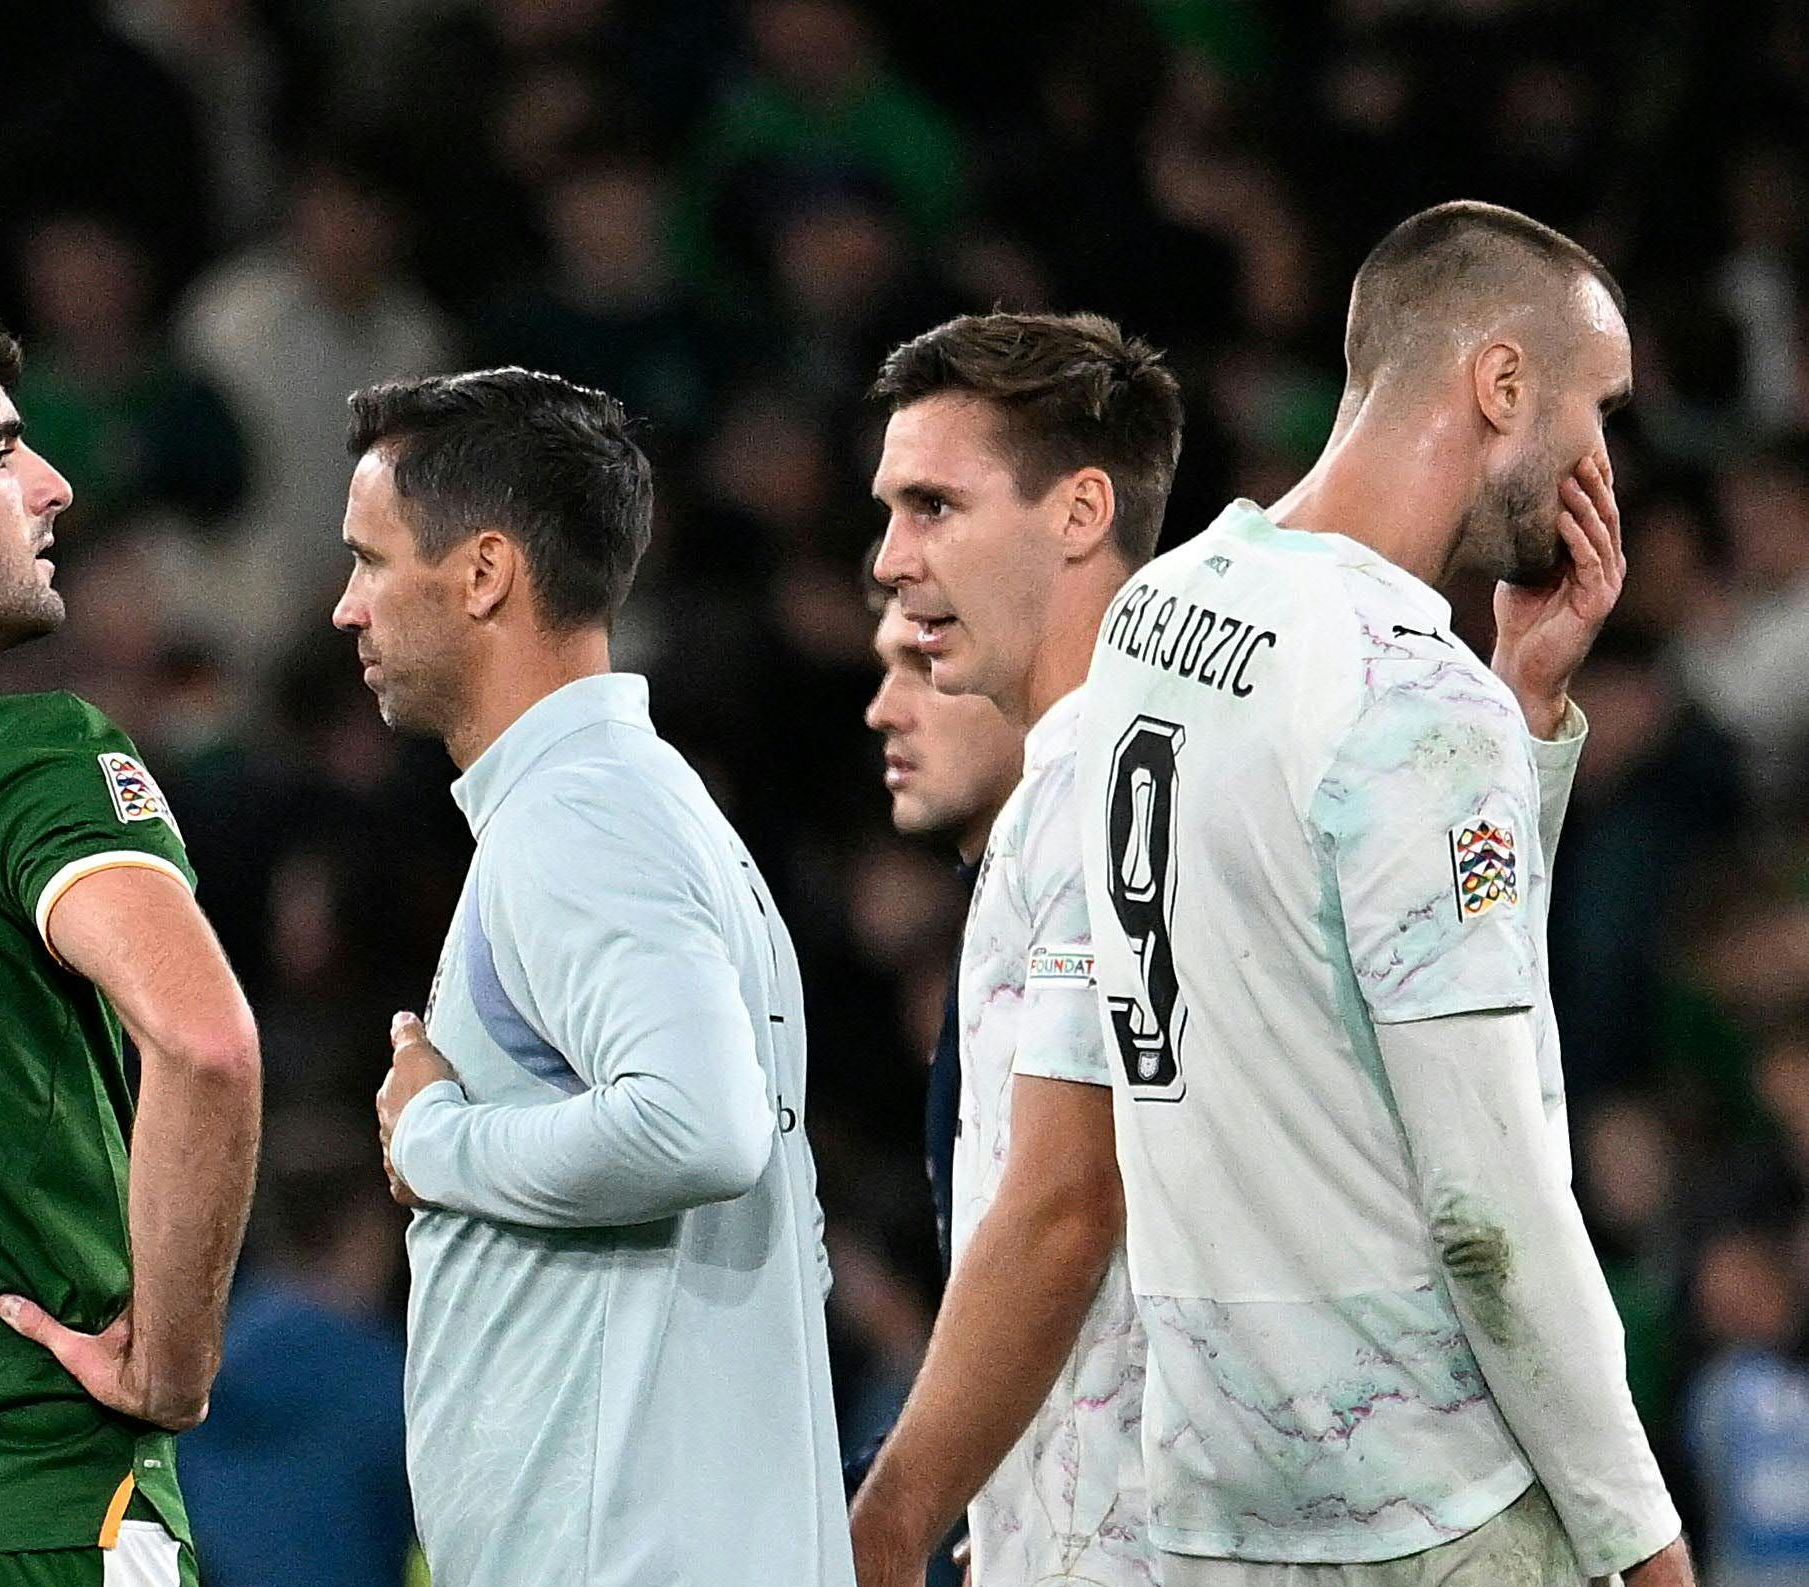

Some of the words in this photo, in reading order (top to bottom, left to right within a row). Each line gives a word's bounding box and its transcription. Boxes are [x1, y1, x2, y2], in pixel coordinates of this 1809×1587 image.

[1103, 579, 1277, 698] ALAJDZIC
[1030, 959, 1095, 975] FOUNDAT
[1106, 714, 1188, 1102] 9
